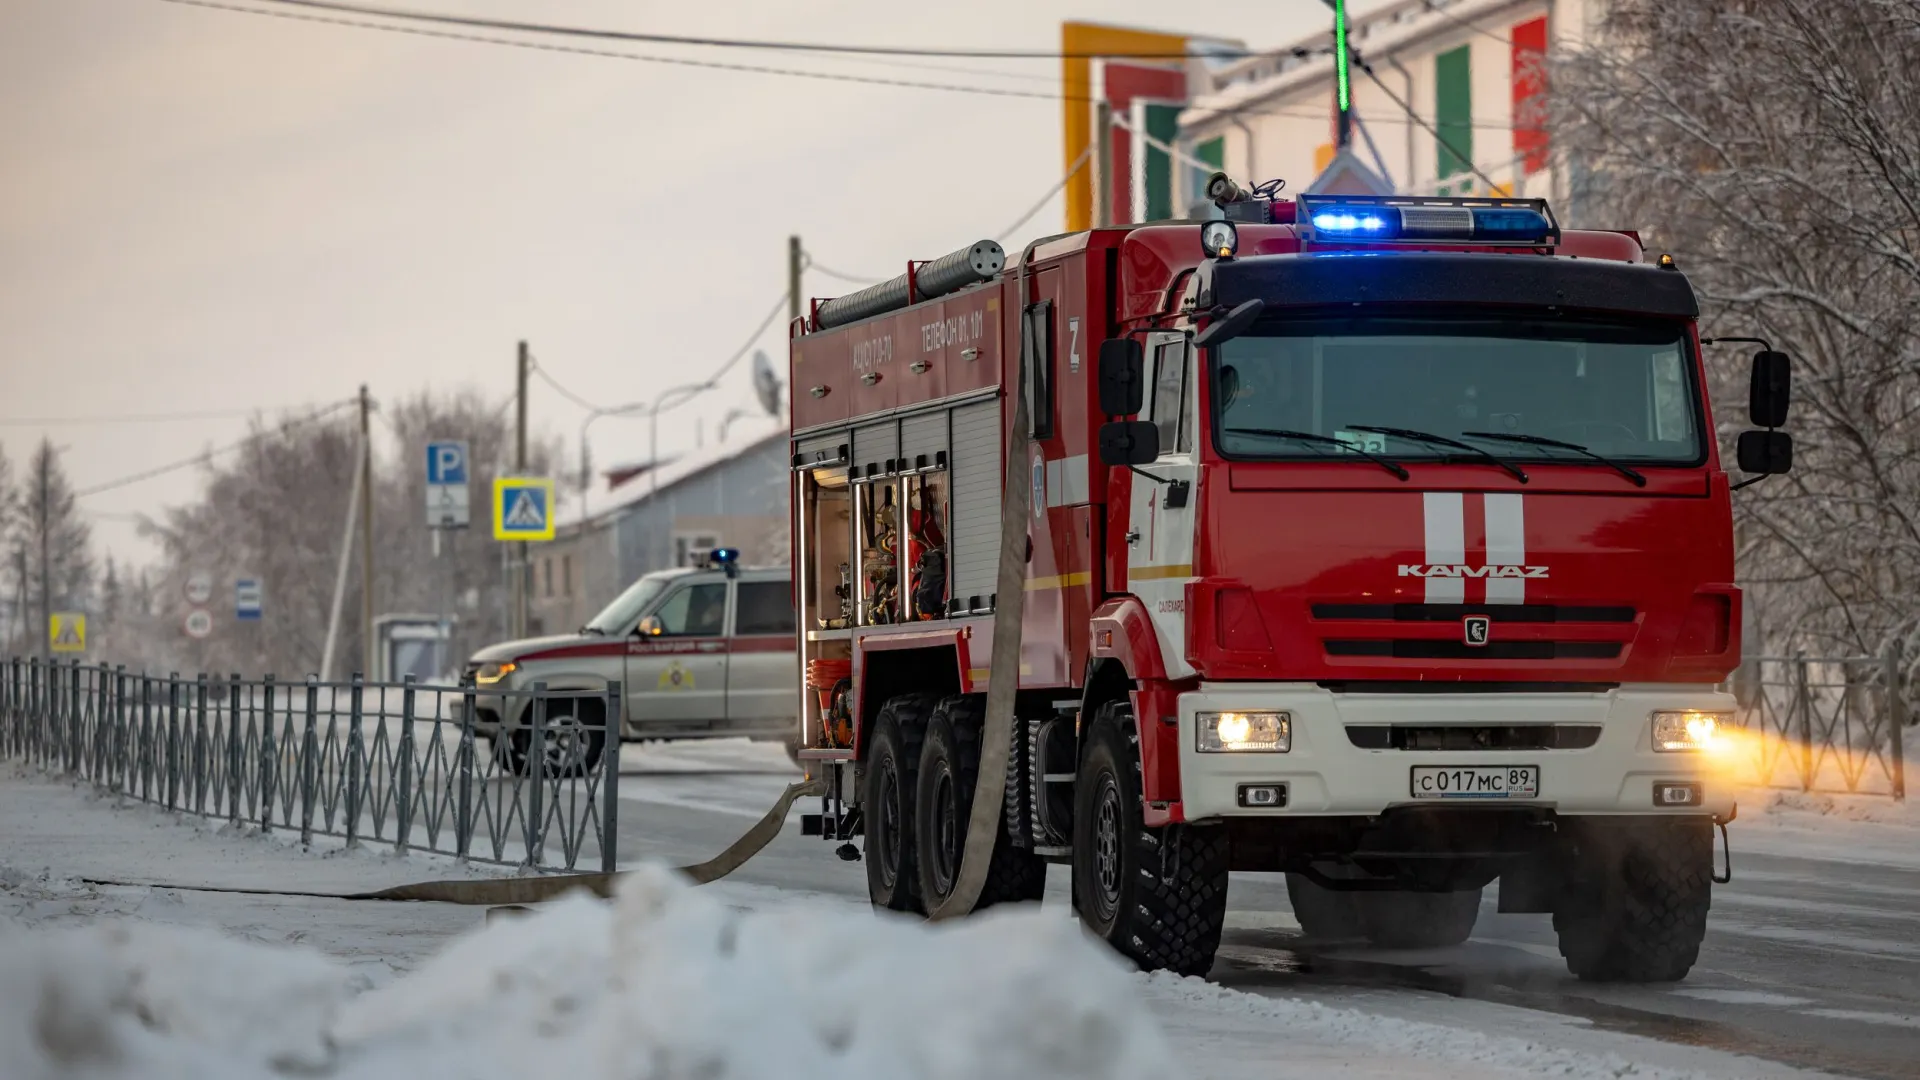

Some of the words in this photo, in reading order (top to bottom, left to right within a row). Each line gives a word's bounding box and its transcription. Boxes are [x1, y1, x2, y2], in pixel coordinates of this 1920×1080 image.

[921, 317, 958, 353] ТЕЛЕФОН
[971, 309, 983, 339] 101
[437, 448, 461, 480] P
[1397, 564, 1550, 578] KAMAZ
[1509, 769, 1529, 785] 89
